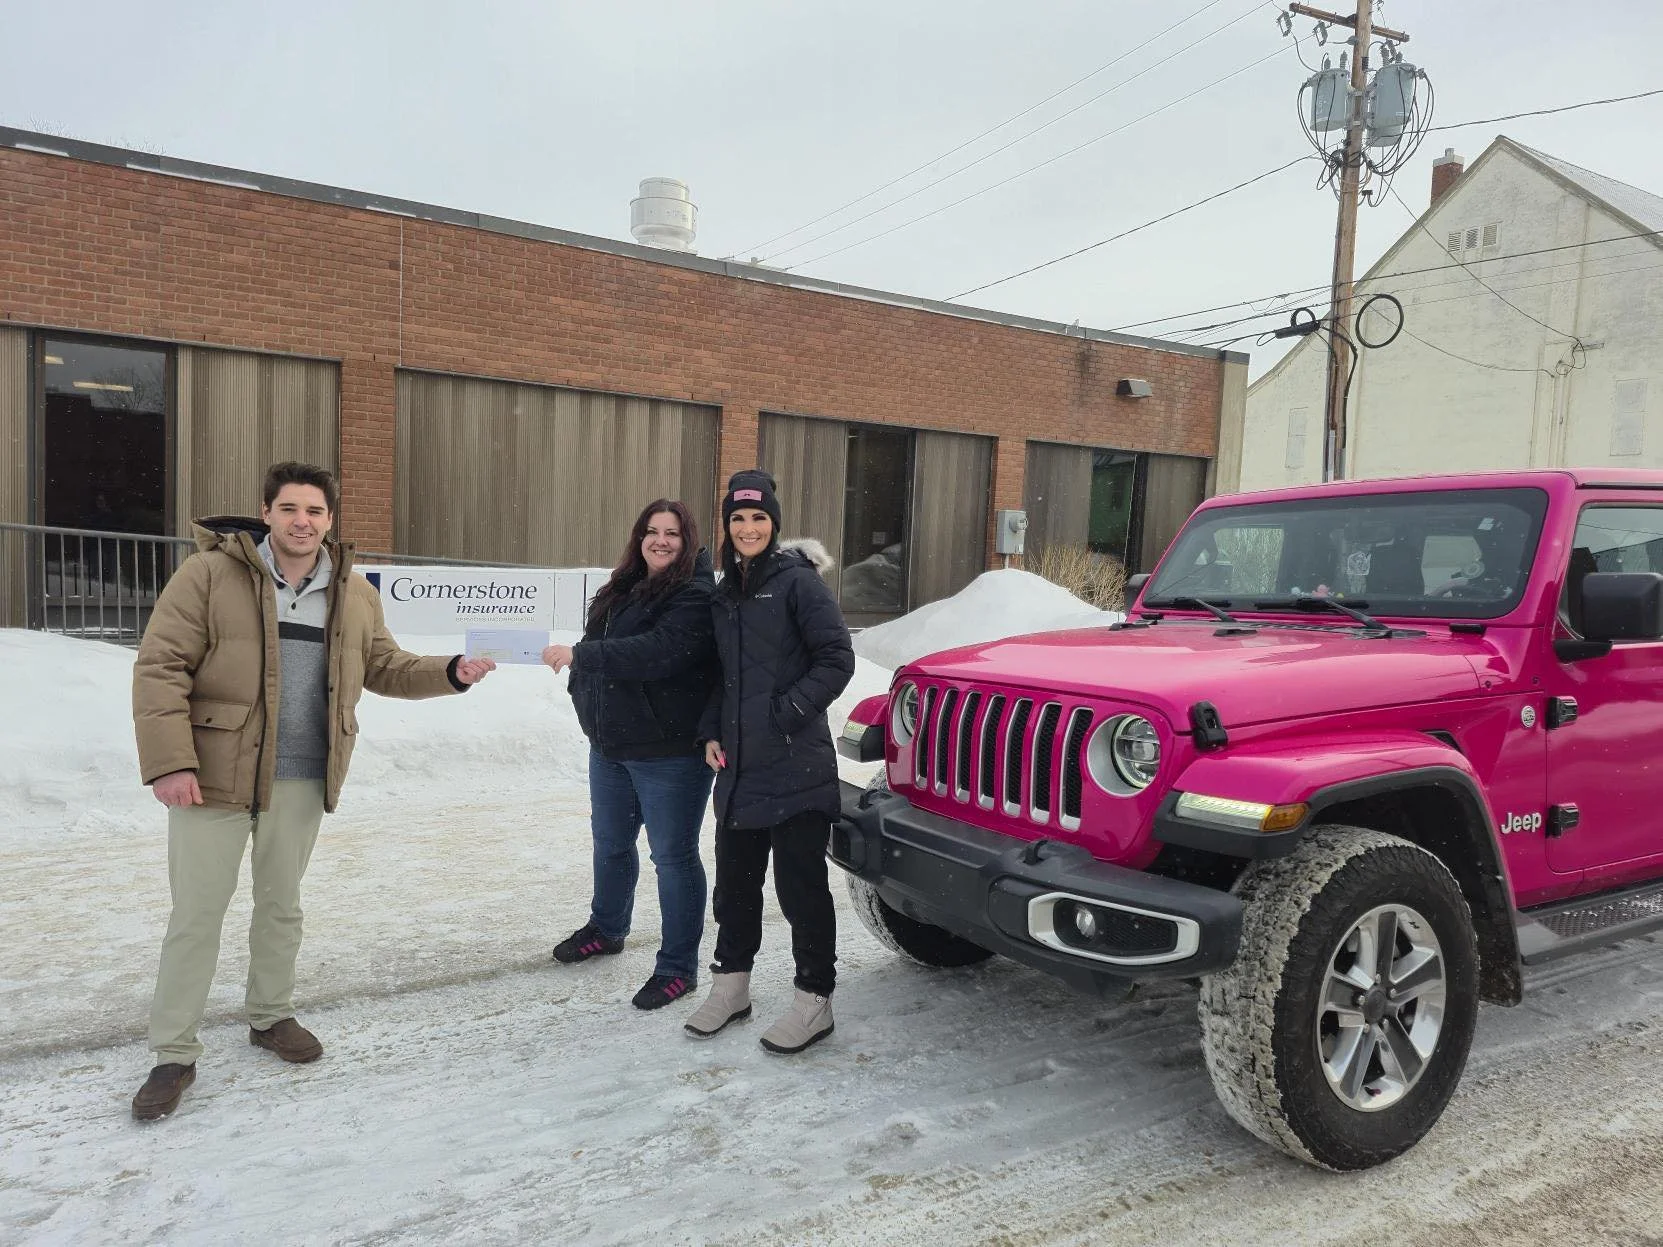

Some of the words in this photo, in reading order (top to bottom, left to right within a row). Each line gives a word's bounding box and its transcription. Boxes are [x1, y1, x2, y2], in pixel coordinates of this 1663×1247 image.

[390, 577, 538, 602] Cornerstone
[456, 601, 536, 614] insurance
[1501, 812, 1542, 834] Jeep
